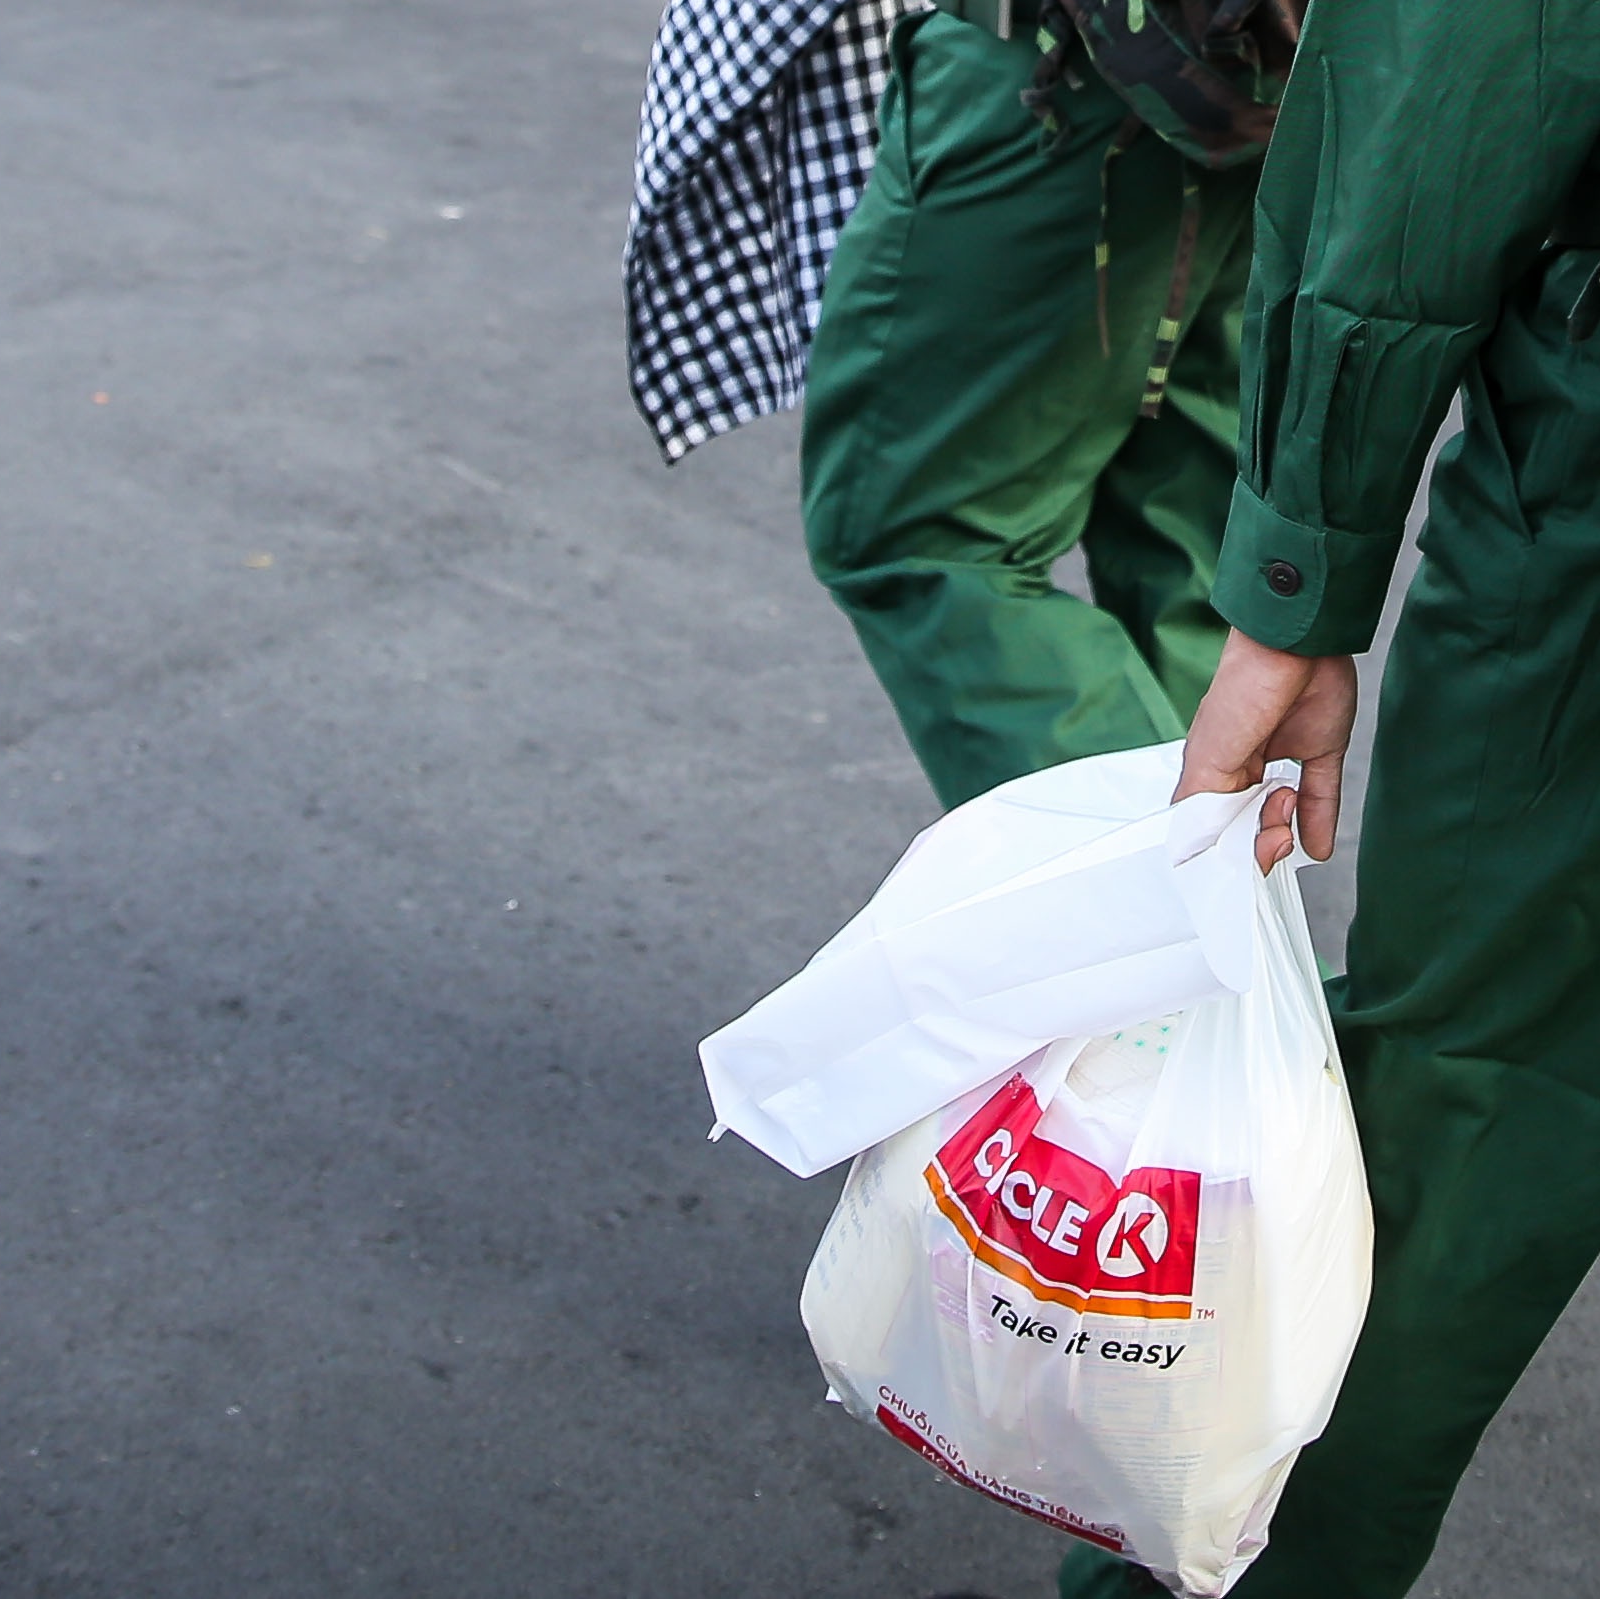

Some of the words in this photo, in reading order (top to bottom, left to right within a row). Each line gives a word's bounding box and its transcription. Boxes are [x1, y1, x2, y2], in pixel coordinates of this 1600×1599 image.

[973, 1128, 1090, 1256] CICLE
[1104, 1207, 1159, 1273] K
[991, 1294, 1058, 1344] Take
[1064, 1330, 1091, 1355] it
[1100, 1340, 1187, 1370] easy
